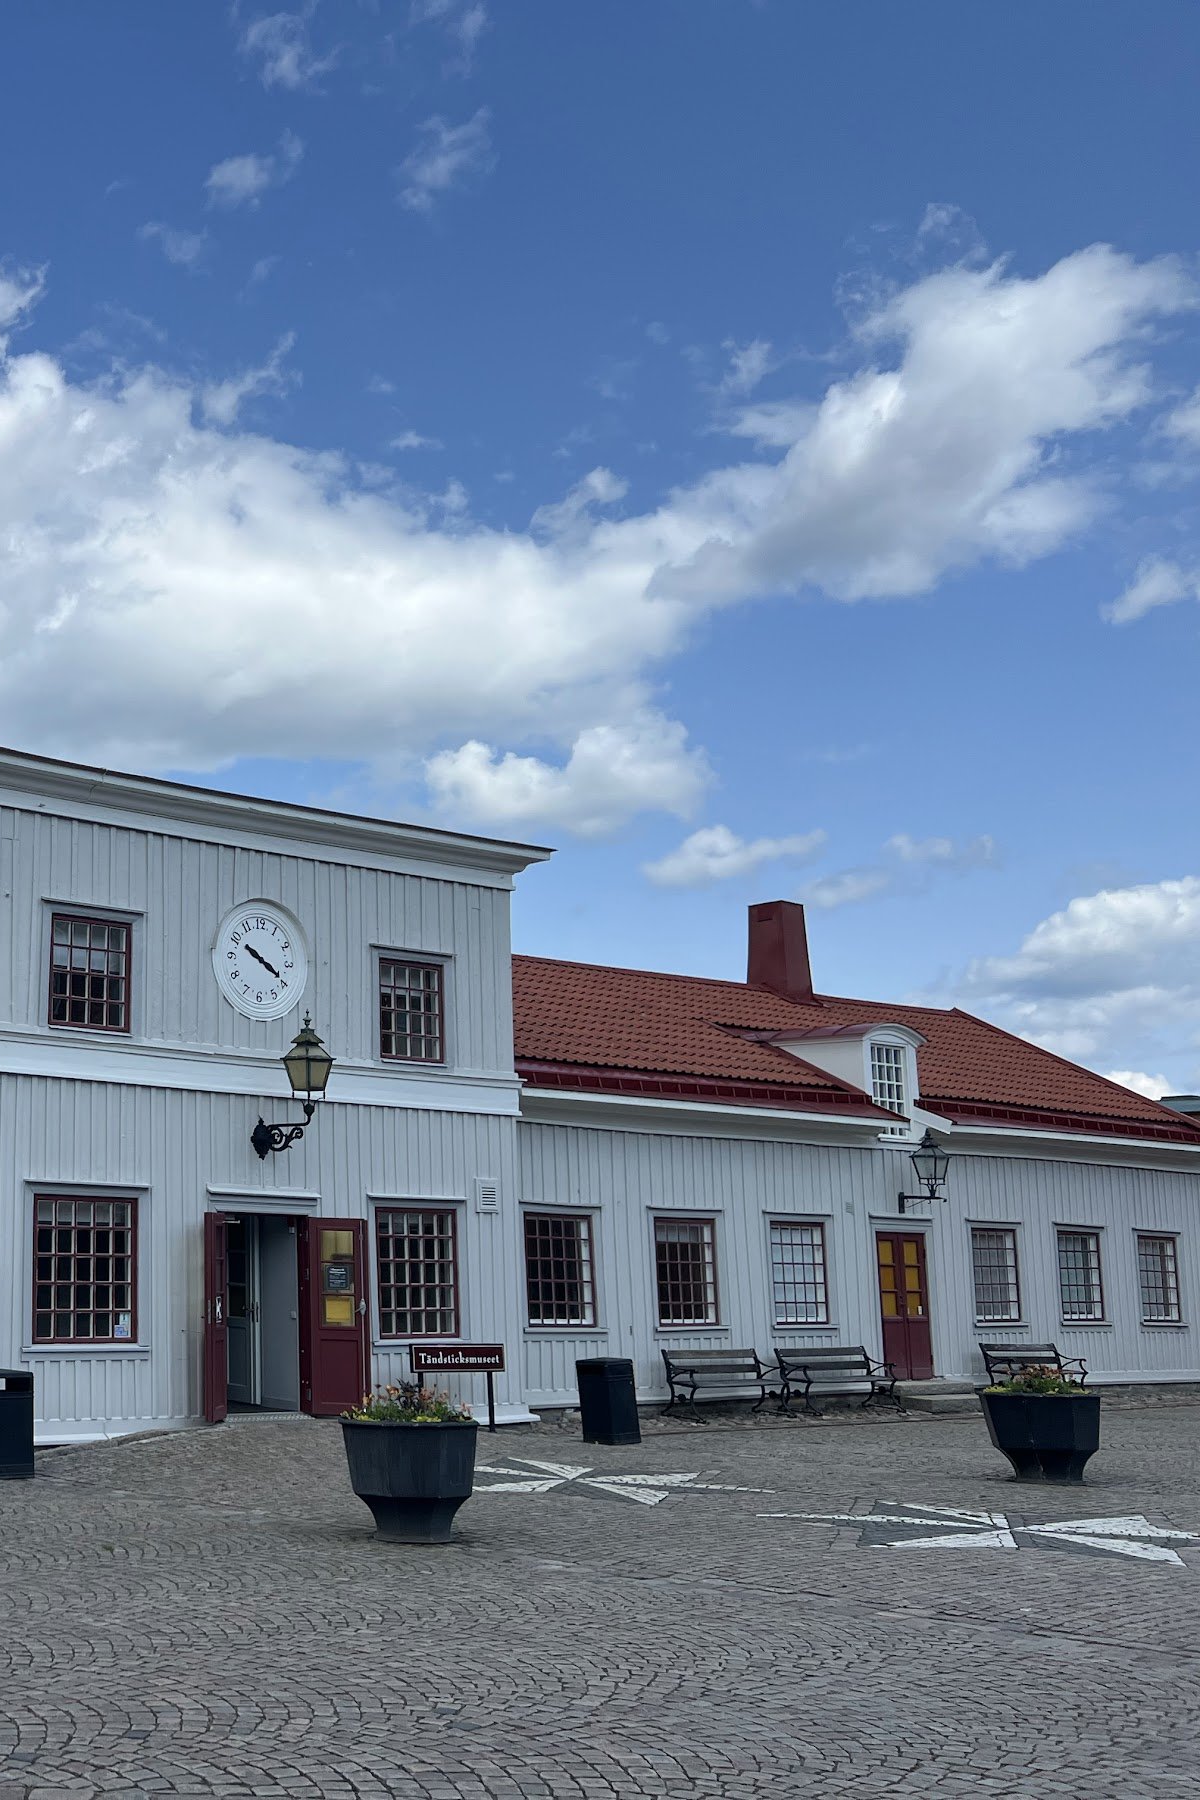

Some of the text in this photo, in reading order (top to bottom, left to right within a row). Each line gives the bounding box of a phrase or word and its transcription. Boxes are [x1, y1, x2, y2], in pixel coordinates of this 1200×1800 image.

[242, 920, 252, 933] 11
[256, 918, 266, 930] 12
[271, 926, 278, 937] 1
[230, 931, 242, 946] 10
[281, 941, 290, 952] 2
[226, 951, 237, 960] 9
[284, 960, 294, 969] 3
[230, 970, 240, 980] 8
[242, 984, 250, 995] 7
[280, 979, 288, 990] 4
[256, 991, 263, 1003] 6
[270, 988, 278, 1000] 5
[418, 1351, 500, 1364] Tändsticksmuseet
